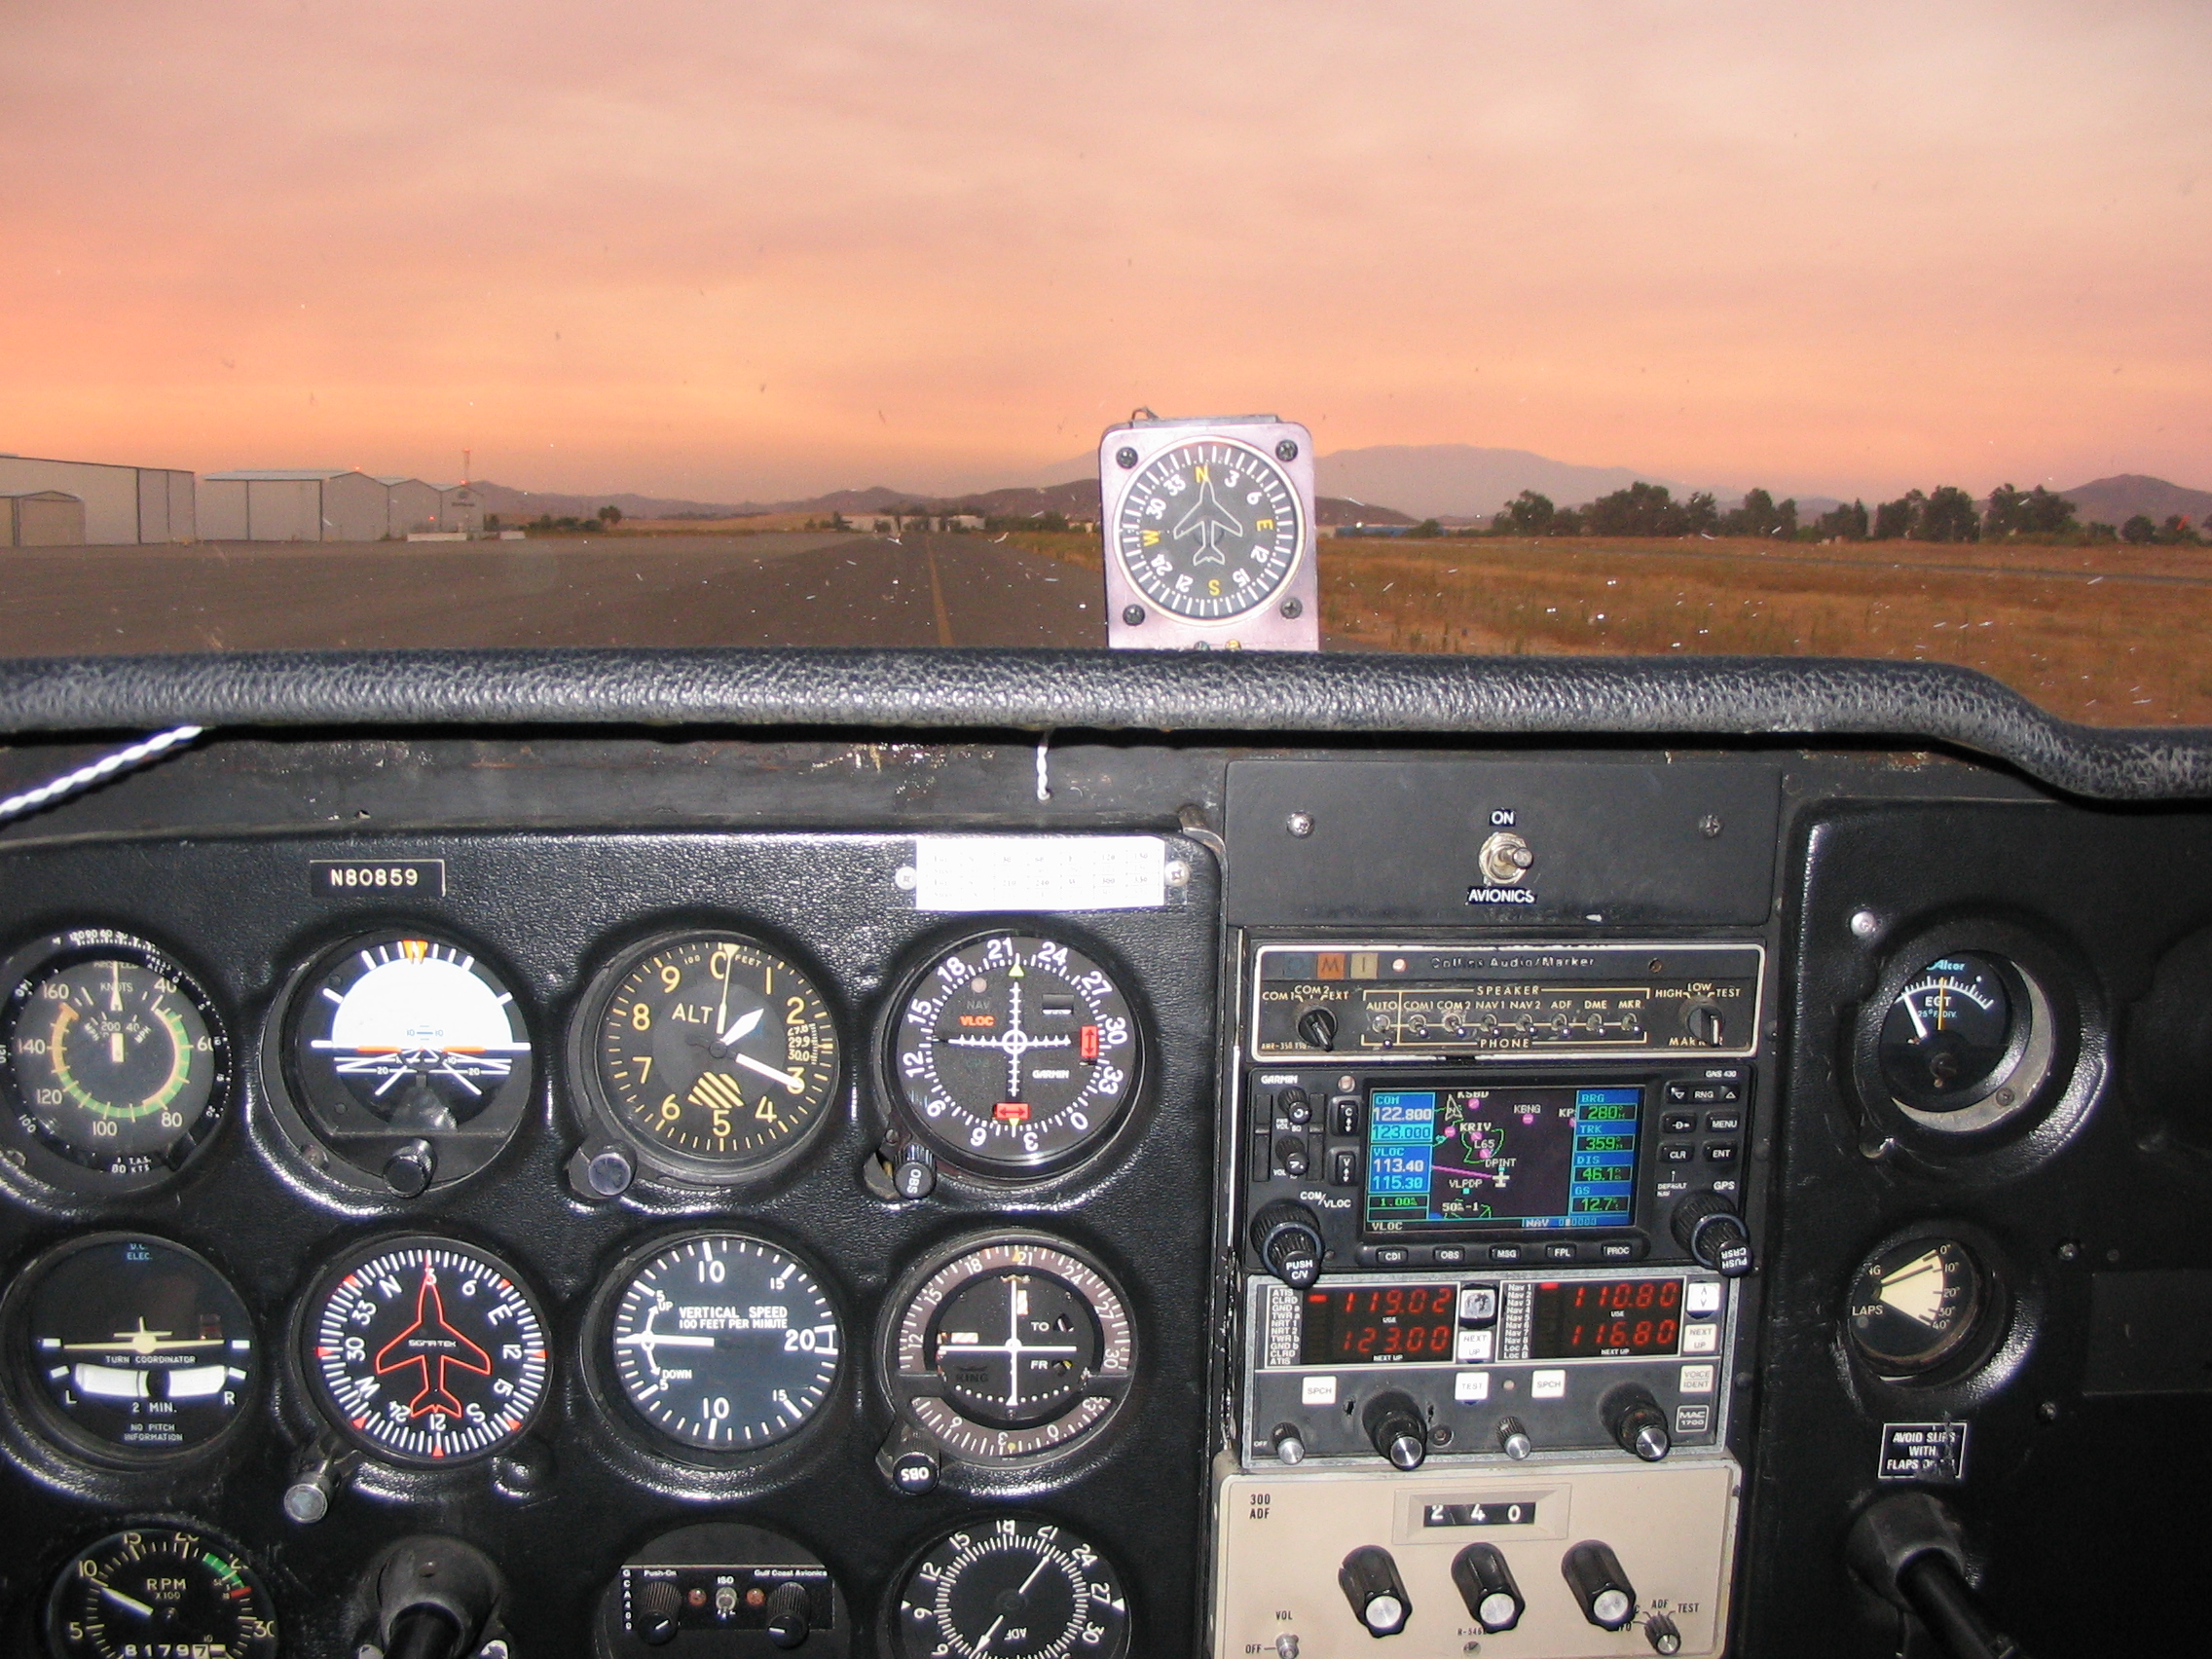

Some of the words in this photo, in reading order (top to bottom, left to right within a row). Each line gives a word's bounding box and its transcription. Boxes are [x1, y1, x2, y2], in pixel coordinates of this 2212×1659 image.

[1195, 465, 1209, 483] N
[1225, 470, 1240, 488] 3
[1257, 519, 1273, 532] E
[1143, 530, 1161, 547] W
[1208, 579, 1221, 596] S
[1492, 810, 1515, 826] ON
[330, 868, 420, 887] N80859
[1468, 889, 1535, 903] AVIONICS
[986, 937, 1014, 960] 21
[1038, 941, 1069, 967] 24
[735, 954, 762, 968] FEET
[1431, 957, 1485, 969] Collns
[1926, 959, 1967, 972] Alcor
[937, 956, 967, 983] 18
[660, 965, 681, 994] 9
[1081, 971, 1113, 996] 27
[43, 983, 69, 1000] 160
[1476, 985, 1539, 996] SPEAKER
[1687, 982, 1713, 992] LOW
[1715, 988, 1742, 998] TEST
[1329, 991, 1349, 1001] EXT
[1655, 989, 1683, 999] HIGH
[1366, 1000, 1398, 1011] AUTO
[1550, 1000, 1572, 1010] ADF
[1584, 1000, 1607, 1010] DME
[1618, 1000, 1641, 1010] MKR
[1924, 995, 1952, 1008] EGT
[671, 1003, 714, 1024] ALT
[786, 996, 805, 1025] 2
[632, 1003, 651, 1031] 8
[959, 1015, 996, 1027] VLOC
[18, 1041, 46, 1054] 140
[1479, 1038, 1530, 1049] PHONE
[633, 1056, 652, 1085] 7
[903, 1050, 925, 1079] 12
[1032, 1069, 1070, 1080] GARMIN
[1261, 1074, 1299, 1085] GARMIN
[36, 1089, 62, 1105] 120
[1375, 1096, 1400, 1105] COM
[1581, 1093, 1604, 1103] BRG
[1694, 1090, 1714, 1099] RNG
[661, 1093, 681, 1121] 6
[755, 1095, 777, 1123] 4
[161, 1112, 183, 1128] 80
[1373, 1108, 1432, 1121] 122.800
[713, 1109, 731, 1137] 5
[1459, 1122, 1493, 1132] KRIV
[1580, 1124, 1603, 1134] TRK
[1713, 1120, 1738, 1129] MENU
[92, 1123, 118, 1137] 100
[1373, 1125, 1431, 1140] 123.000
[1373, 1147, 1405, 1157] VLOC
[1669, 1151, 1686, 1160] CLR
[1713, 1149, 1731, 1159] ENT
[1577, 1155, 1600, 1164] DIS
[1373, 1159, 1424, 1173] 113.40
[906, 1168, 922, 1194] OBS
[1373, 1175, 1423, 1190] 115.30
[1714, 1181, 1735, 1191] GPS
[1575, 1186, 1590, 1196] GS
[1372, 1221, 1403, 1232] VLOC
[1526, 1218, 1550, 1228] NAV
[1384, 1252, 1402, 1262] CDI
[1440, 1250, 1460, 1260] OBS
[1496, 1249, 1517, 1259] MSG
[1554, 1248, 1571, 1258] FPL
[1606, 1246, 1630, 1256] PROC
[1286, 1260, 1313, 1271] PUSH
[1721, 1257, 1749, 1270] PUSH
[697, 1260, 726, 1283] 10
[1291, 1270, 1309, 1280] C/V
[379, 1273, 403, 1299] N
[461, 1279, 477, 1296] 6
[769, 1277, 785, 1290] 15
[1272, 1288, 1294, 1297] ATIS
[1574, 1281, 1678, 1308] 110.80
[658, 1301, 674, 1311] UP
[1272, 1296, 1299, 1305] CLRD
[1344, 1287, 1453, 1314] 119.02
[488, 1303, 513, 1325] E
[679, 1306, 740, 1319] VERTICAL
[749, 1306, 788, 1318] SPEED
[679, 1318, 698, 1330] 100
[700, 1318, 725, 1330] FEET
[729, 1318, 750, 1330] PER
[752, 1318, 788, 1330] MINUTE
[1030, 1321, 1050, 1332] TO
[1571, 1318, 1677, 1346] 116.80
[1689, 1327, 1712, 1336] NEXT
[784, 1328, 816, 1352] 20
[1343, 1325, 1451, 1352] 123.00
[1693, 1341, 1707, 1349] UP
[105, 1355, 129, 1364] TURN
[135, 1355, 197, 1364] COORDINATOR
[1030, 1360, 1049, 1370] FR
[662, 1369, 692, 1380] DOWN
[1683, 1370, 1711, 1380] VOICE
[354, 1375, 381, 1398] W
[1536, 1380, 1562, 1388] SPCH
[1682, 1380, 1710, 1388] IDENT
[65, 1389, 78, 1405] L
[224, 1390, 236, 1406] R
[132, 1402, 140, 1413] 2
[149, 1402, 177, 1413] MIN.
[466, 1402, 486, 1423] S
[702, 1396, 730, 1419] 10
[1678, 1411, 1706, 1419] MAC
[149, 1422, 175, 1432] PITCH
[1892, 1431, 1923, 1444] AVOID
[1908, 1445, 1936, 1457] WITH
[1886, 1458, 1919, 1471] FLAPS
[900, 1466, 930, 1482] OBS
[1249, 1494, 1272, 1506] 300
[1249, 1508, 1270, 1520] ADF
[754, 1568, 770, 1577] Gulf
[146, 1578, 187, 1590] RPM
[717, 1575, 735, 1584] ISO
[1651, 1600, 1669, 1609] ADF
[1677, 1603, 1700, 1614] TEST
[1275, 1610, 1293, 1621] VOL
[1004, 1627, 1028, 1641] ADF
[1245, 1643, 1262, 1654] OFF
